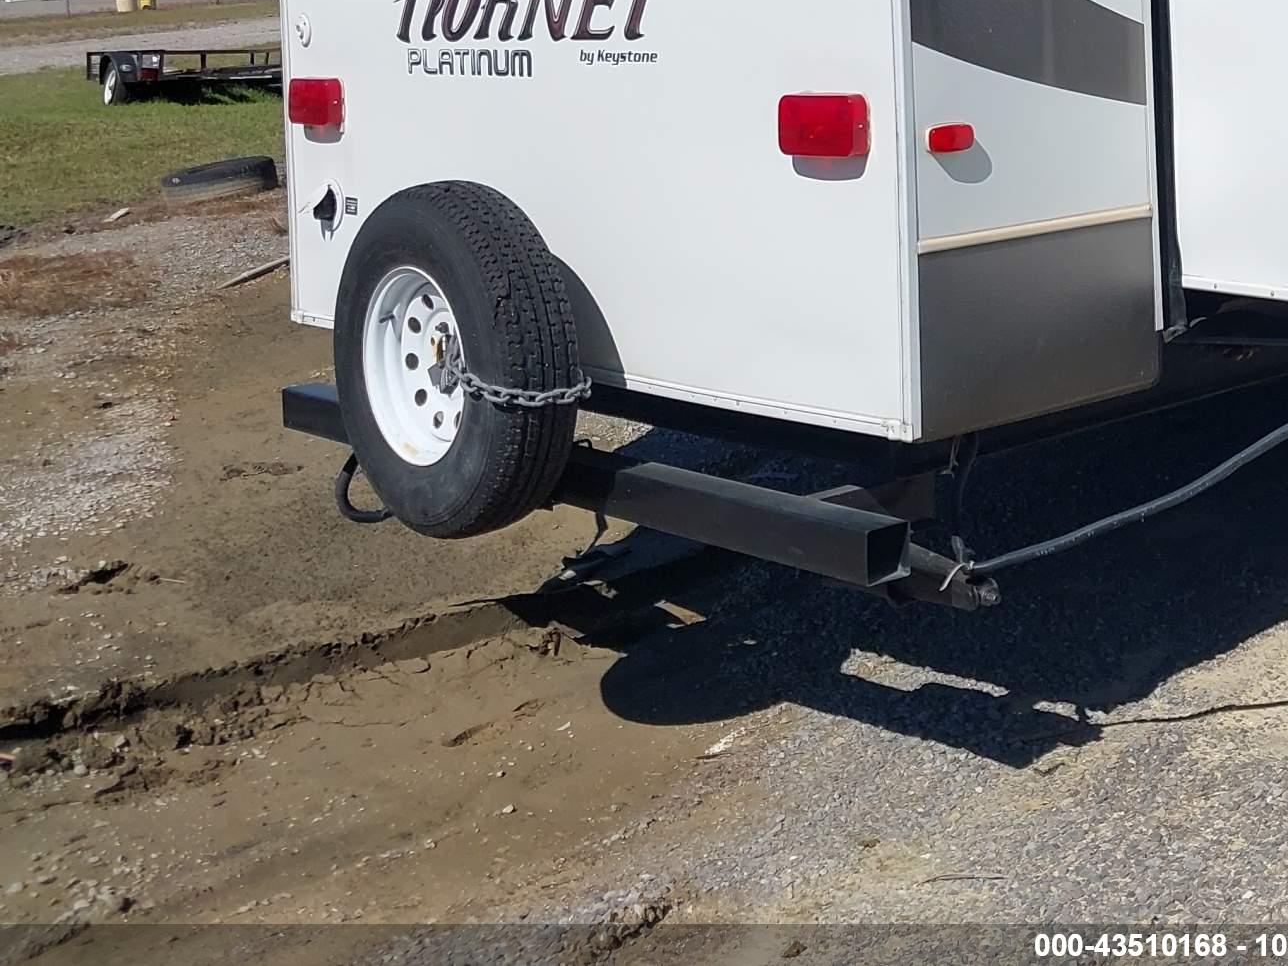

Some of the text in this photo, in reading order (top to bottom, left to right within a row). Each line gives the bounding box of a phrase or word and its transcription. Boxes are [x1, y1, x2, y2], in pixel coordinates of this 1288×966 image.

[407, 48, 533, 78] PLATINUM
[579, 49, 658, 66] by Keystone
